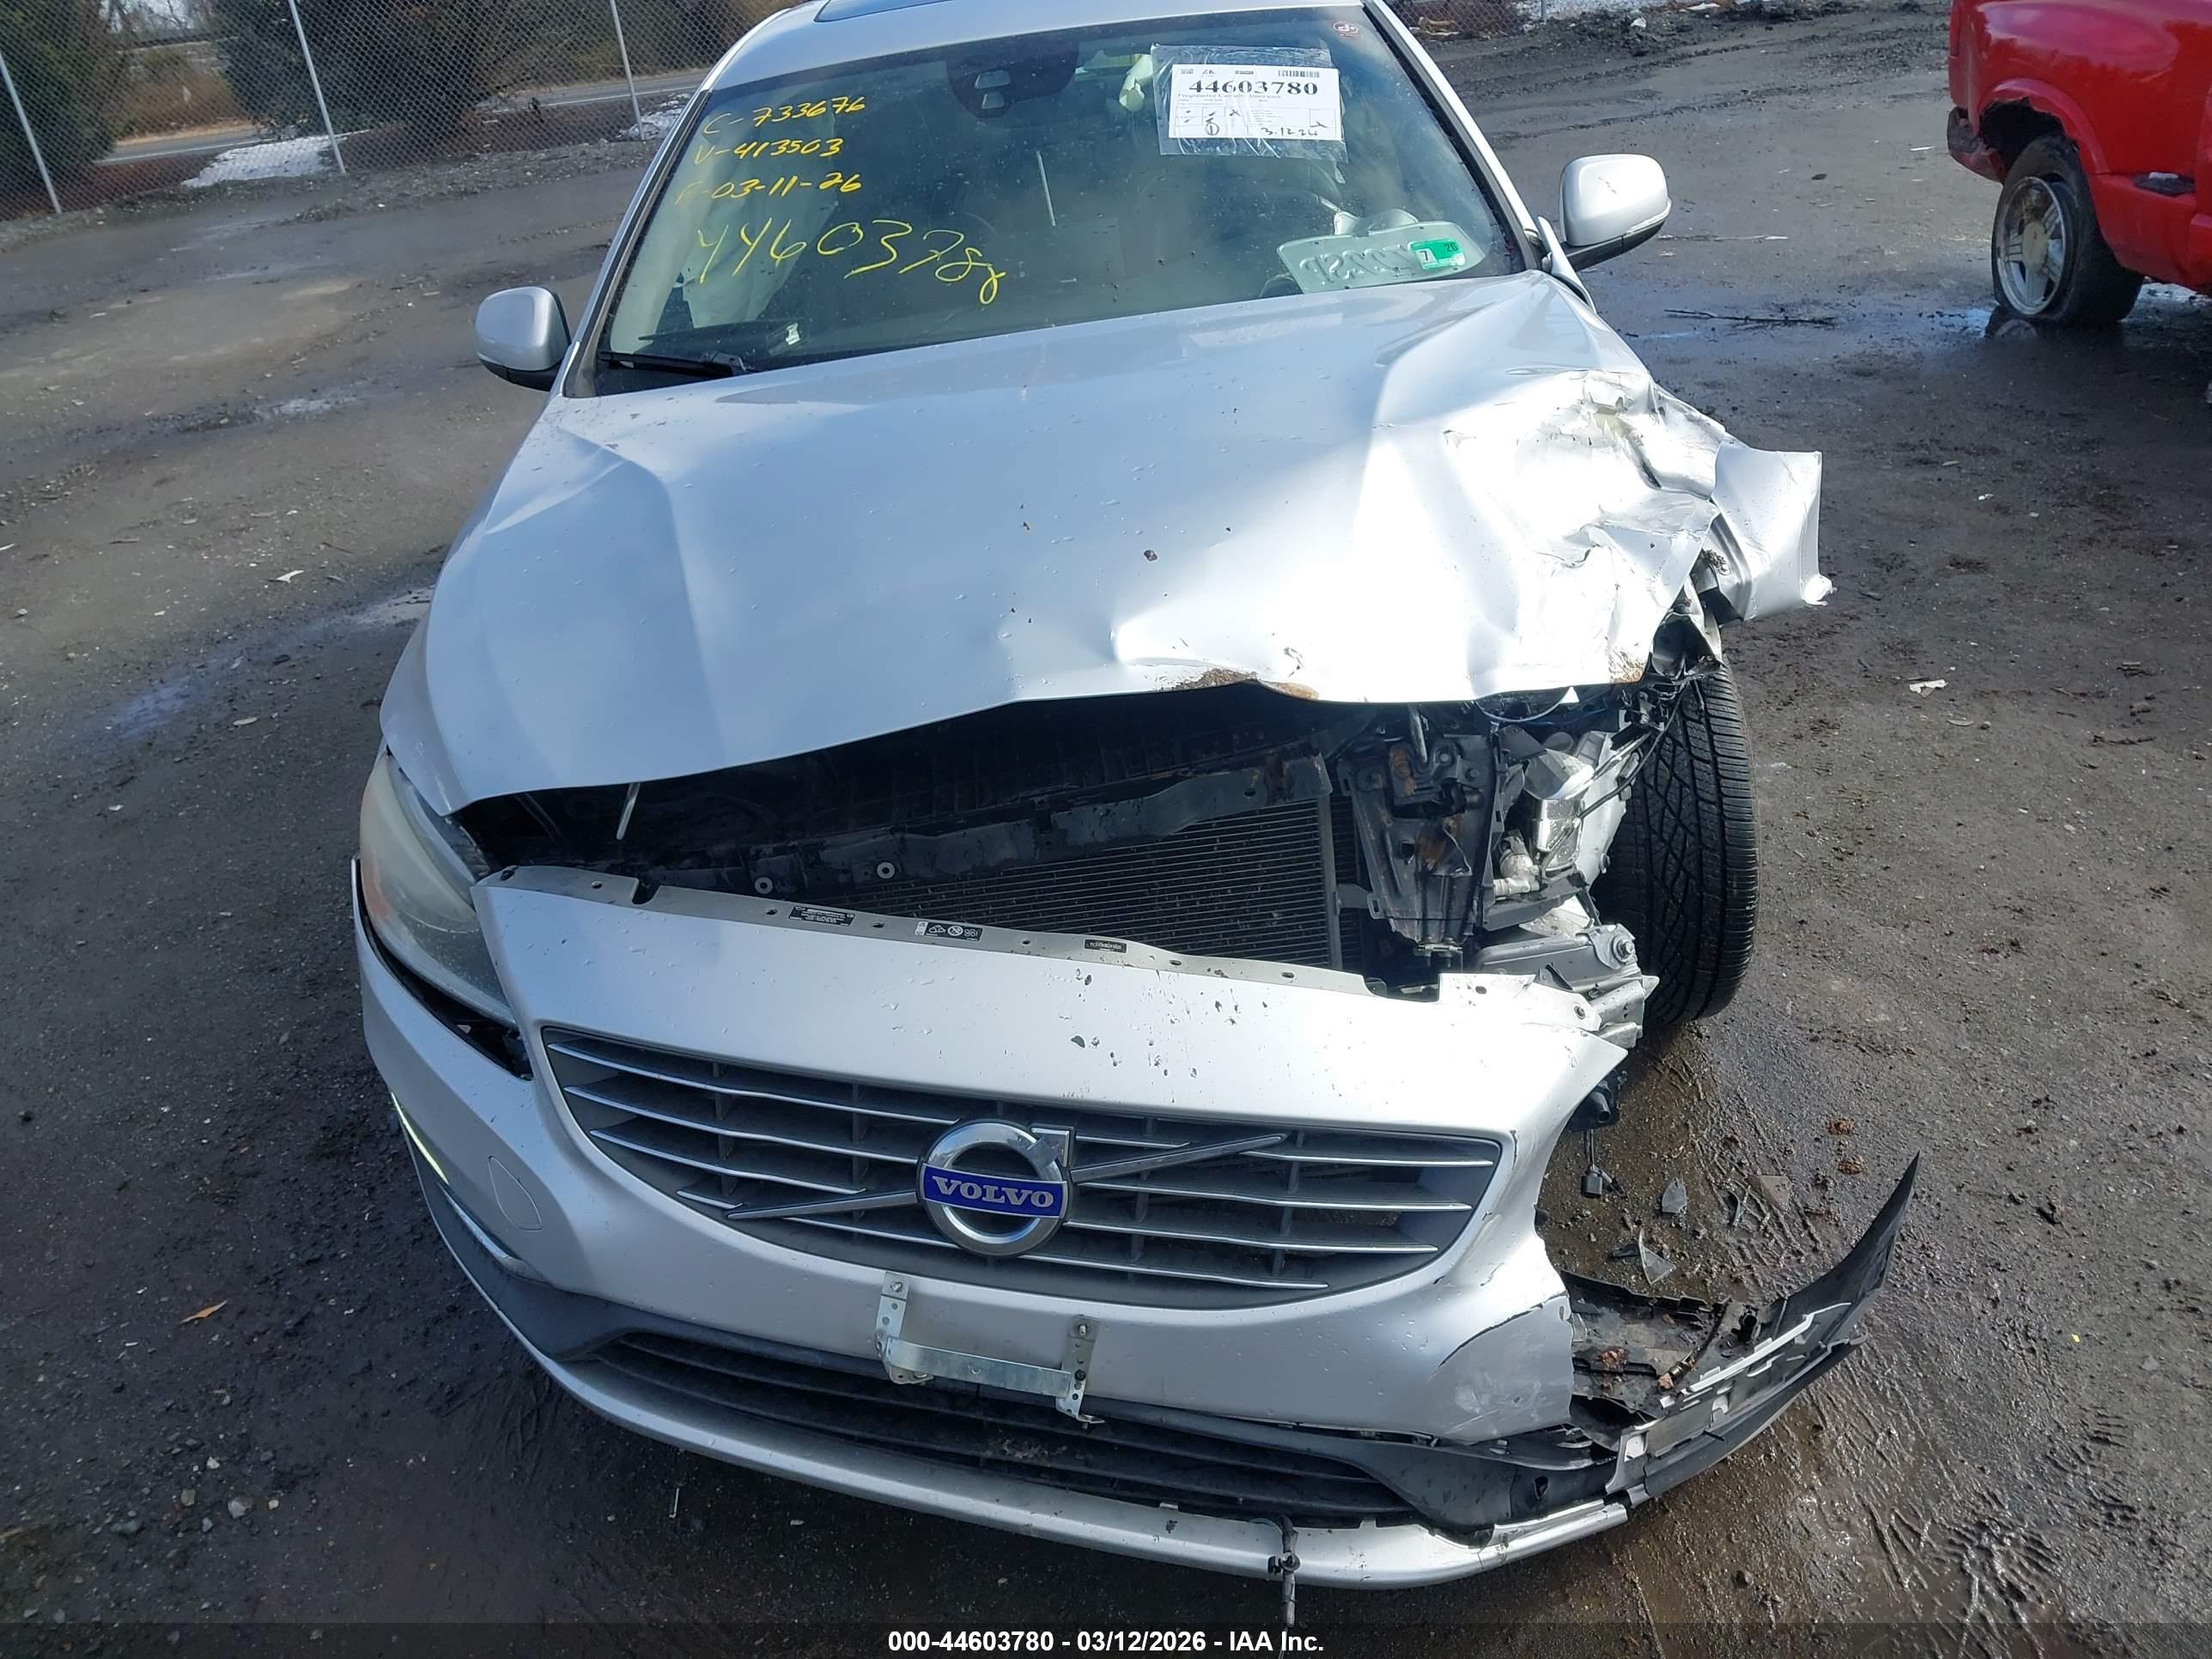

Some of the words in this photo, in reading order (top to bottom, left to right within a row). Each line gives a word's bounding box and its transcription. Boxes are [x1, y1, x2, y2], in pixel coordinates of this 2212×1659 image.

[1188, 79, 1318, 95] 44603780
[704, 96, 866, 135] C-733676
[694, 137, 844, 165] V-413503
[1419, 250, 1429, 262] 7
[1443, 240, 1459, 252] 26
[932, 1175, 1054, 1208] VOLVO
